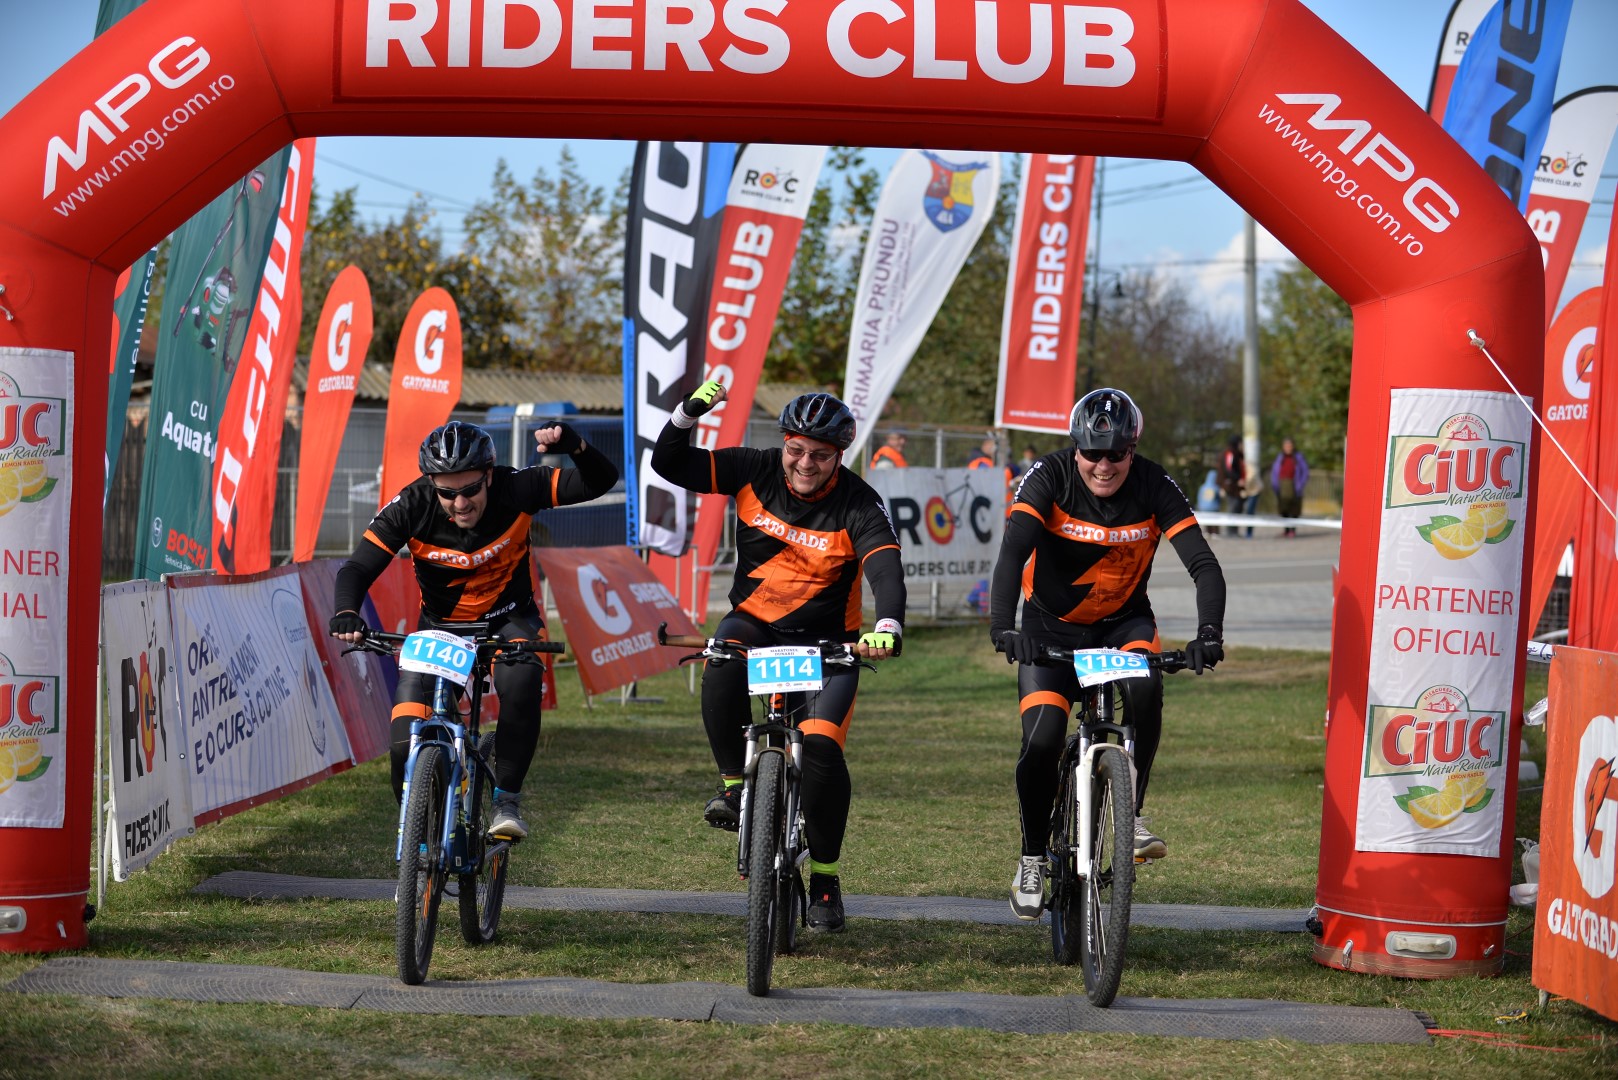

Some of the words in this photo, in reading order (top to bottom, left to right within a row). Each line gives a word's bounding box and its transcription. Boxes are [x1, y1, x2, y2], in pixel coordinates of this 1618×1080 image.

[366, 0, 790, 74] RIDERS
[826, 0, 1136, 88] CLUB
[43, 36, 211, 200] MPG
[53, 74, 236, 218] www.mpg.com.ro
[1275, 94, 1461, 234] MPG
[1258, 104, 1424, 257] www.mpg.com.ro
[869, 218, 900, 312] PRUNDU
[709, 221, 774, 351] CLUB
[1028, 222, 1069, 361] RIDERS
[318, 375, 355, 393] GATORADE
[402, 375, 449, 394] GATORADE
[947, 560, 974, 576] CLUB
[1378, 584, 1514, 616] PARTENER
[411, 638, 468, 668] 1140
[591, 631, 656, 667] GATORADE
[1393, 626, 1501, 657] OFICIAL
[756, 658, 815, 679] 1114
[1081, 654, 1142, 670] 1105
